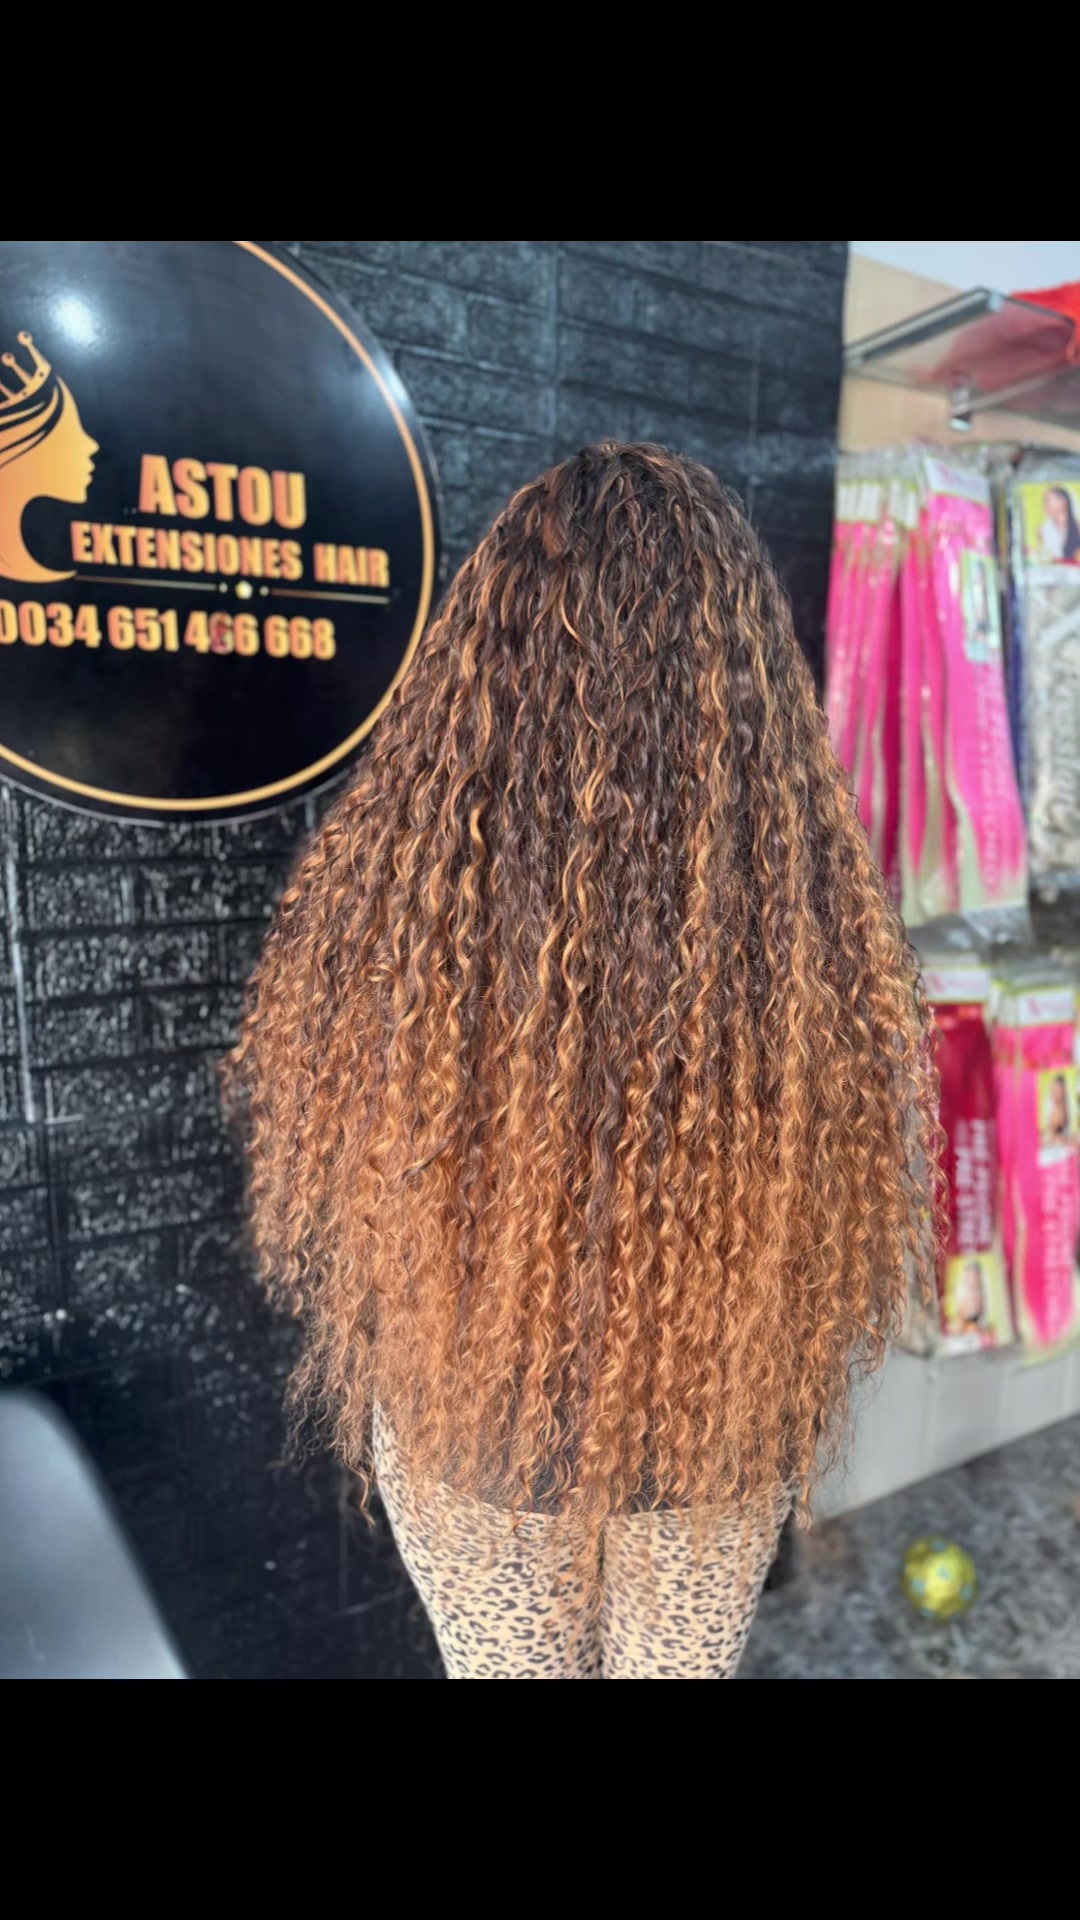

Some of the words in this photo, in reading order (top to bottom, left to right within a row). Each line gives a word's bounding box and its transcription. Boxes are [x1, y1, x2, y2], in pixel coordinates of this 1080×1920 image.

[138, 454, 306, 530] ASTOU
[70, 520, 303, 581] EXTENSIONES
[313, 543, 390, 588] HAIR
[106, 605, 179, 652] 651
[263, 614, 336, 661] 668
